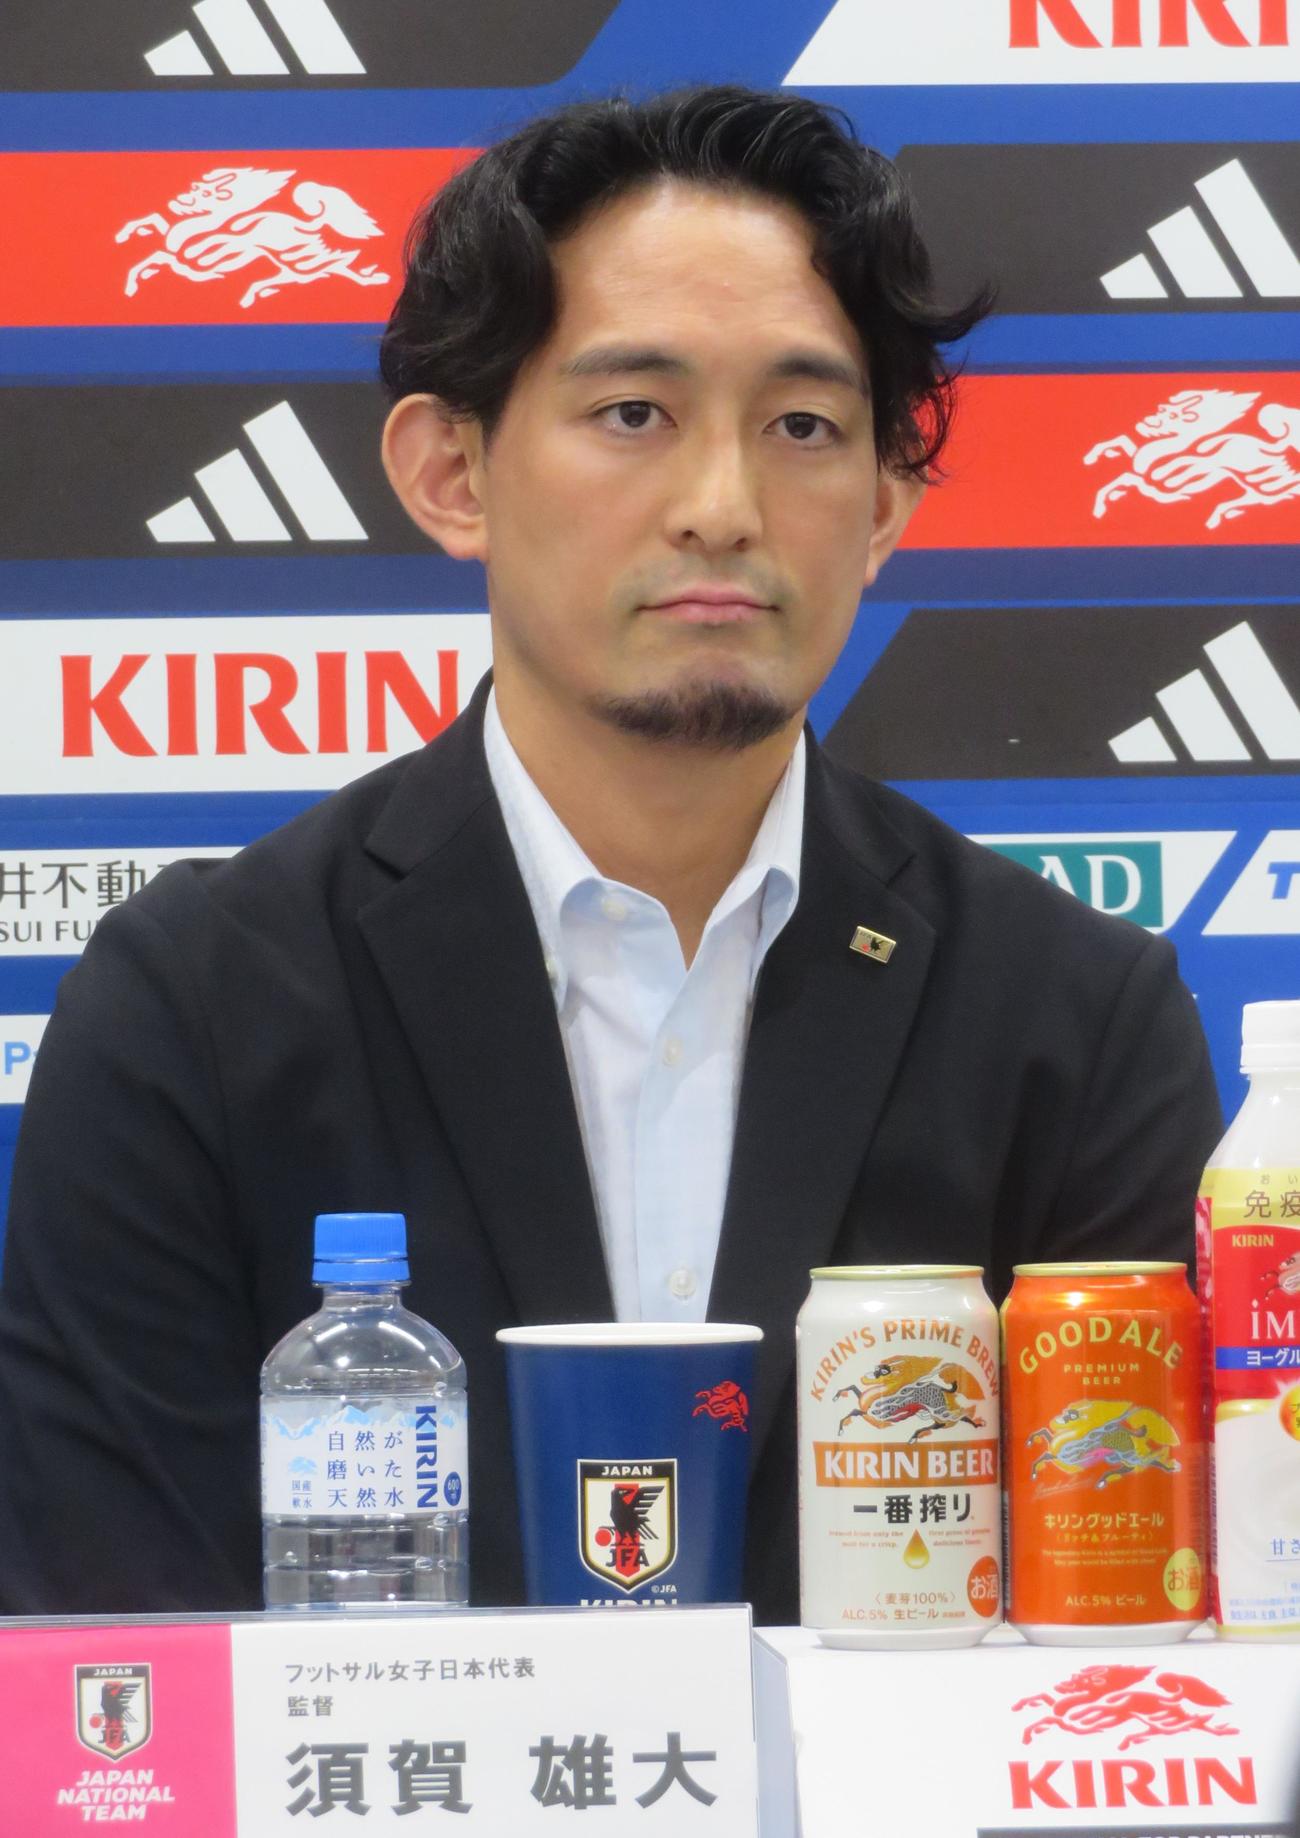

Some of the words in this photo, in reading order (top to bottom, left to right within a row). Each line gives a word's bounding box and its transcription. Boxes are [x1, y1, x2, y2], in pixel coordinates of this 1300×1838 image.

[60, 650, 459, 757] KIRIN
[0, 860, 166, 909] 井不動
[55, 920, 100, 942] FU
[4, 1041, 37, 1075] P
[1232, 1234, 1275, 1247] KIRIN
[1019, 1316, 1113, 1374] GOOD
[1119, 1319, 1184, 1369] ALE
[810, 1326, 876, 1402] KIRIN'S
[882, 1319, 964, 1348] PRIME
[966, 1335, 999, 1397] BREW
[1063, 1363, 1140, 1374] PREMIUM
[1082, 1376, 1121, 1385] BEER
[328, 1431, 404, 1451] 自然が
[415, 1405, 438, 1508] KIRIN
[824, 1450, 919, 1479] KIRIN
[927, 1449, 994, 1478] BEER
[327, 1459, 402, 1480] 磨いた
[601, 1466, 653, 1476] JAPAN
[328, 1487, 404, 1508] 天然水
[853, 1493, 971, 1524] 一番搾り
[1045, 1512, 1164, 1529] キリングッドエール
[606, 1549, 650, 1567] JFA
[1116, 1594, 1146, 1606] ビール
[93, 1667, 133, 1676] JAPAN
[285, 1657, 536, 1682] フットサル女子日本代表
[287, 1694, 334, 1718] 監督
[98, 1729, 131, 1744] JFA
[76, 1769, 154, 1787] JAPAN
[285, 1738, 473, 1818] 須賀
[528, 1731, 718, 1810] 雄大
[1008, 1757, 1258, 1809] KIRIN
[57, 1787, 175, 1806] NATIONAL
[81, 1805, 147, 1822] TEAM
